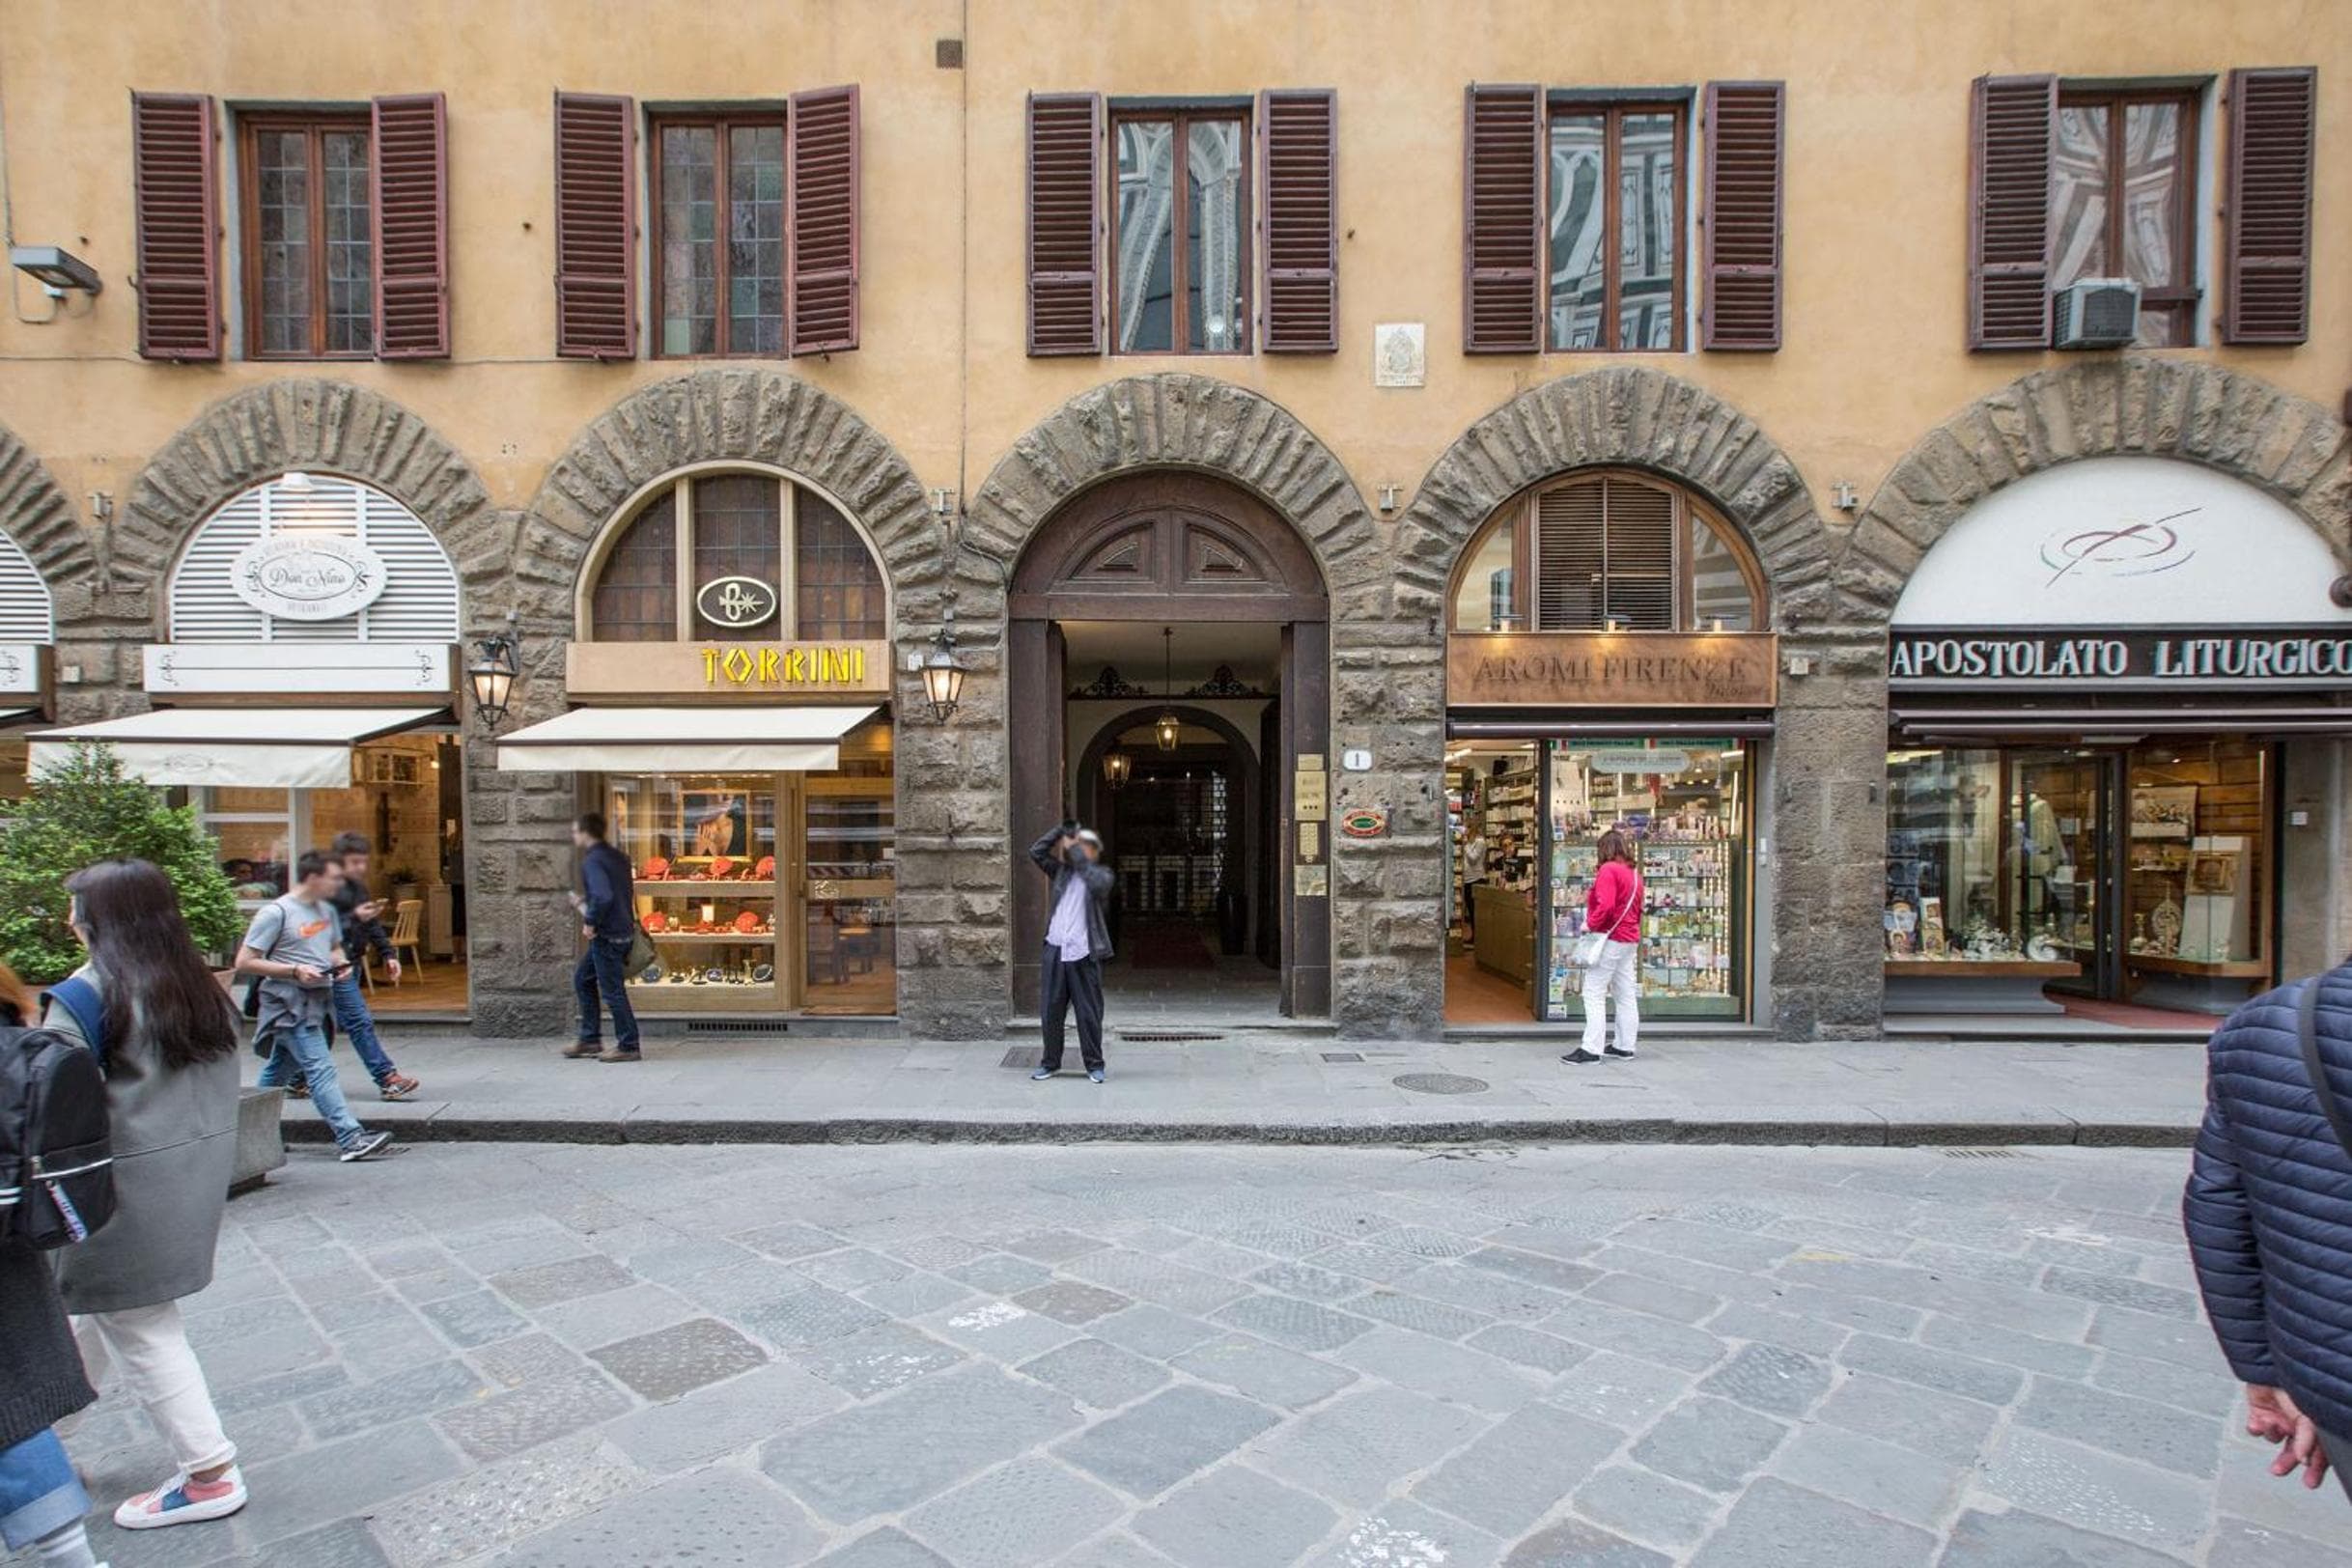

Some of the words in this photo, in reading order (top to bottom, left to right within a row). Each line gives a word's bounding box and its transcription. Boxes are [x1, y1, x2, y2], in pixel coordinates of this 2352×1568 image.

[701, 647, 863, 684] TORRINI
[1472, 654, 1594, 682] AROMI
[1601, 654, 1749, 682] FIRENZE
[1890, 639, 2130, 677] APOSTOLATO
[2154, 638, 2352, 677] LITURGICO
[1354, 752, 1360, 768] 1
